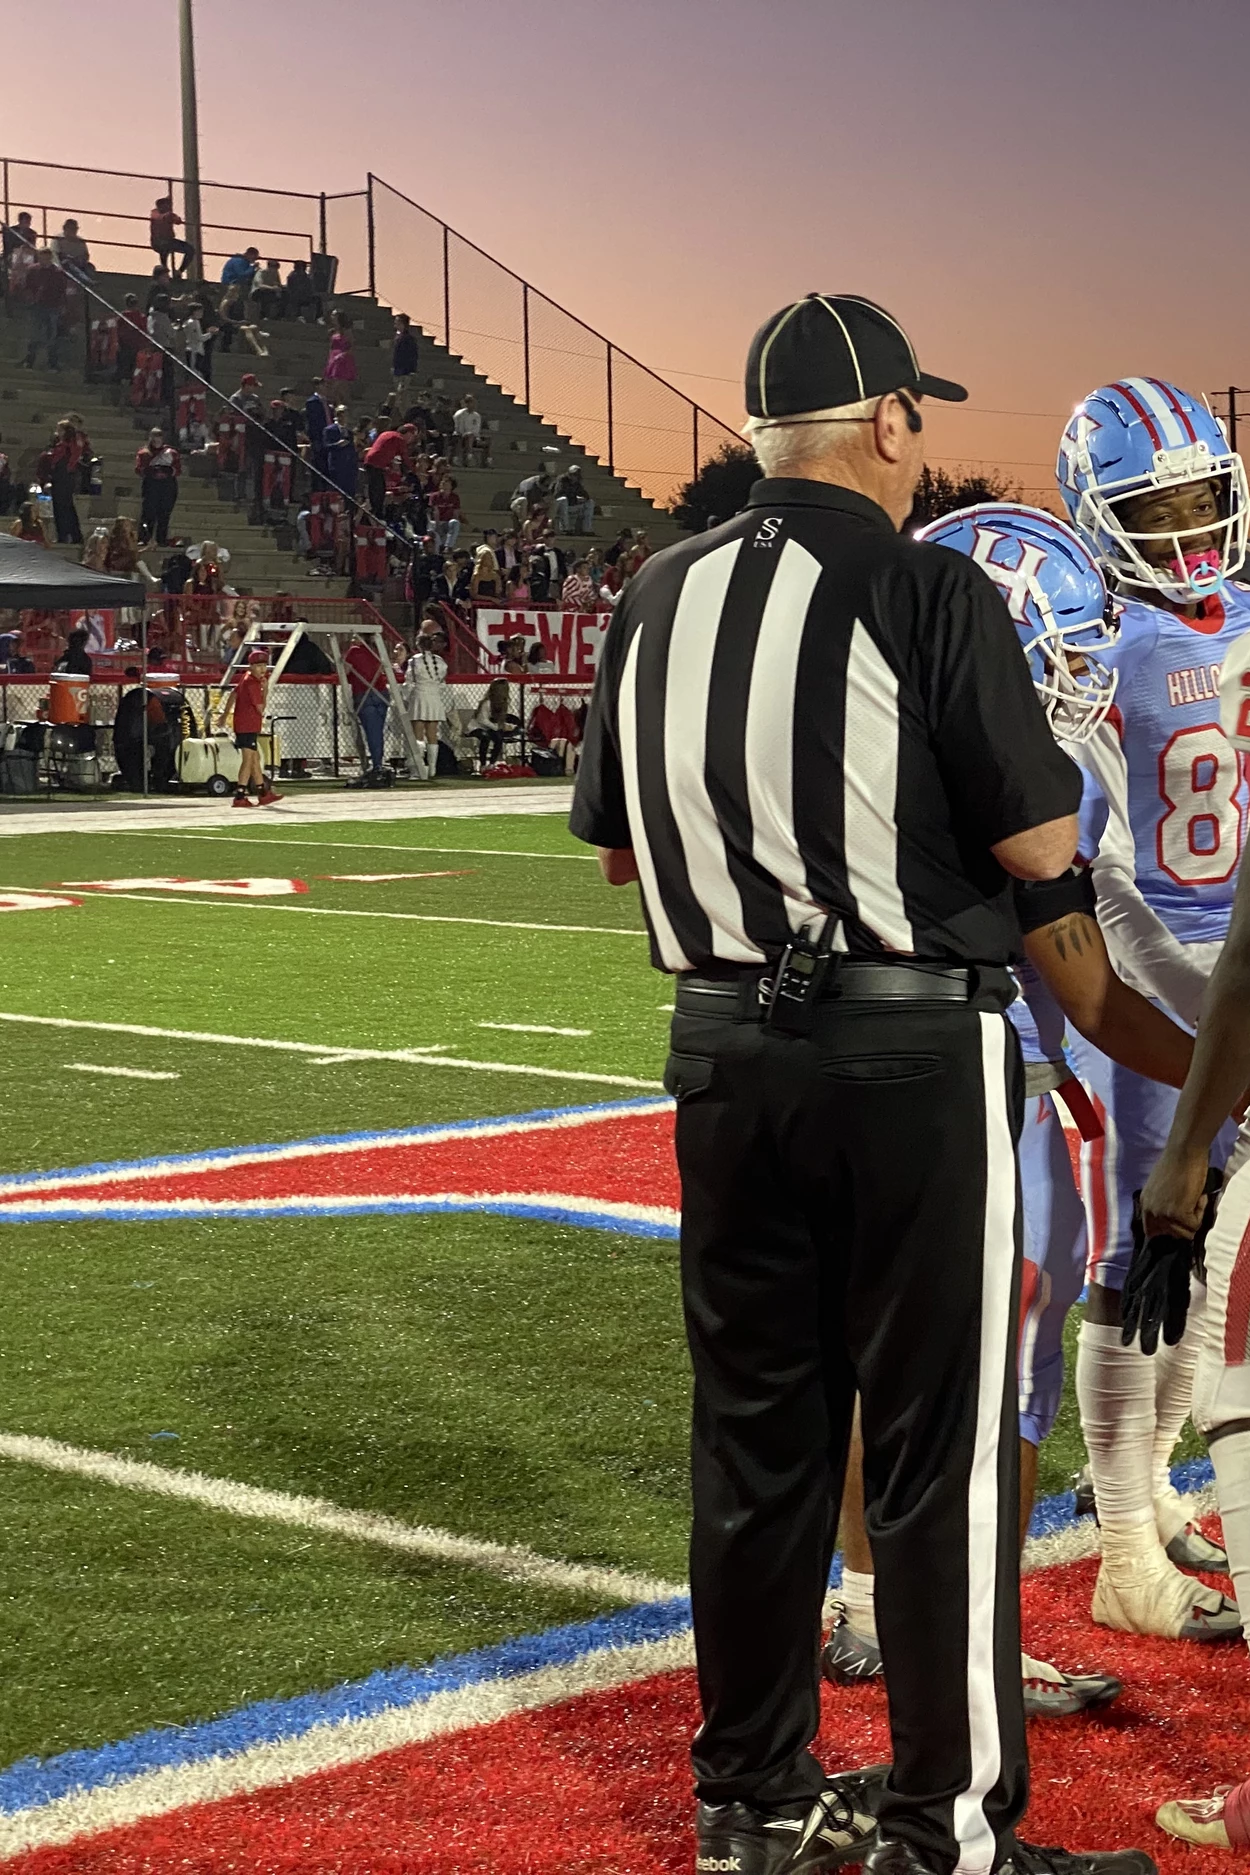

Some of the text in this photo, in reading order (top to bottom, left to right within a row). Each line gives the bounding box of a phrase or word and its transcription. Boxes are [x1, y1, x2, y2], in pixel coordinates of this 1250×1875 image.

[487, 611, 612, 677] #WE'
[1166, 662, 1222, 706] HILLC
[1156, 722, 1248, 886] 8
[696, 1852, 743, 1873] eebok
